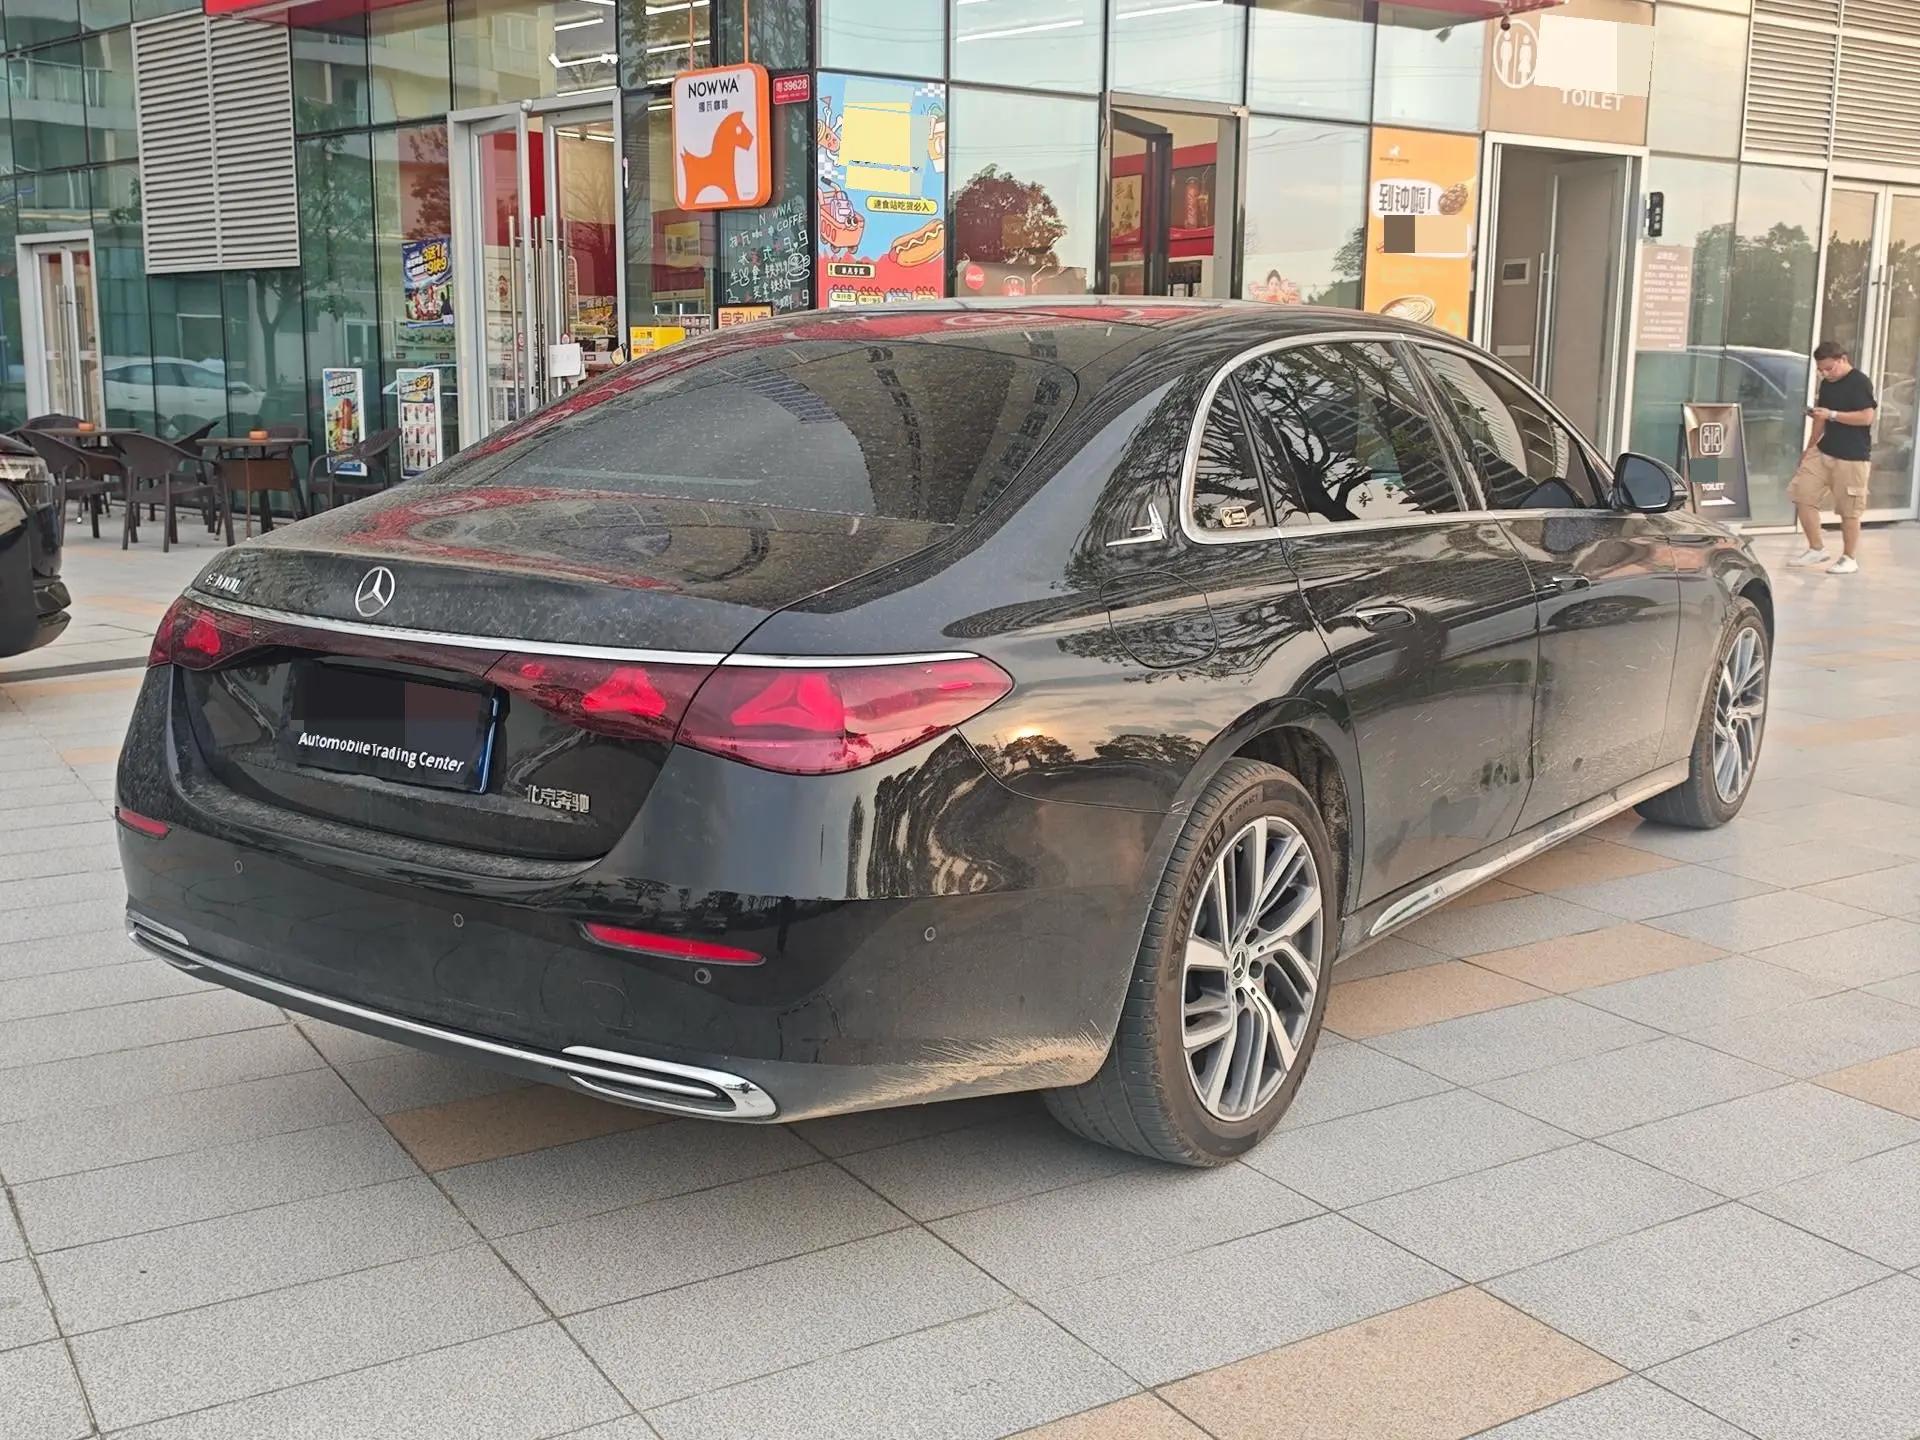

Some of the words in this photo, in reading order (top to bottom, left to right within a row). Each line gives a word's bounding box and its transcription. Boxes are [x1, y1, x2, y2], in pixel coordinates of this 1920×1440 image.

[688, 78, 739, 99] NOWWA
[783, 79, 807, 92] 39628
[1560, 89, 1625, 112] TOILET
[298, 732, 370, 756] Automobile
[371, 743, 418, 769] Trading
[419, 751, 465, 773] Center
[525, 784, 590, 813] 北京奔驰
